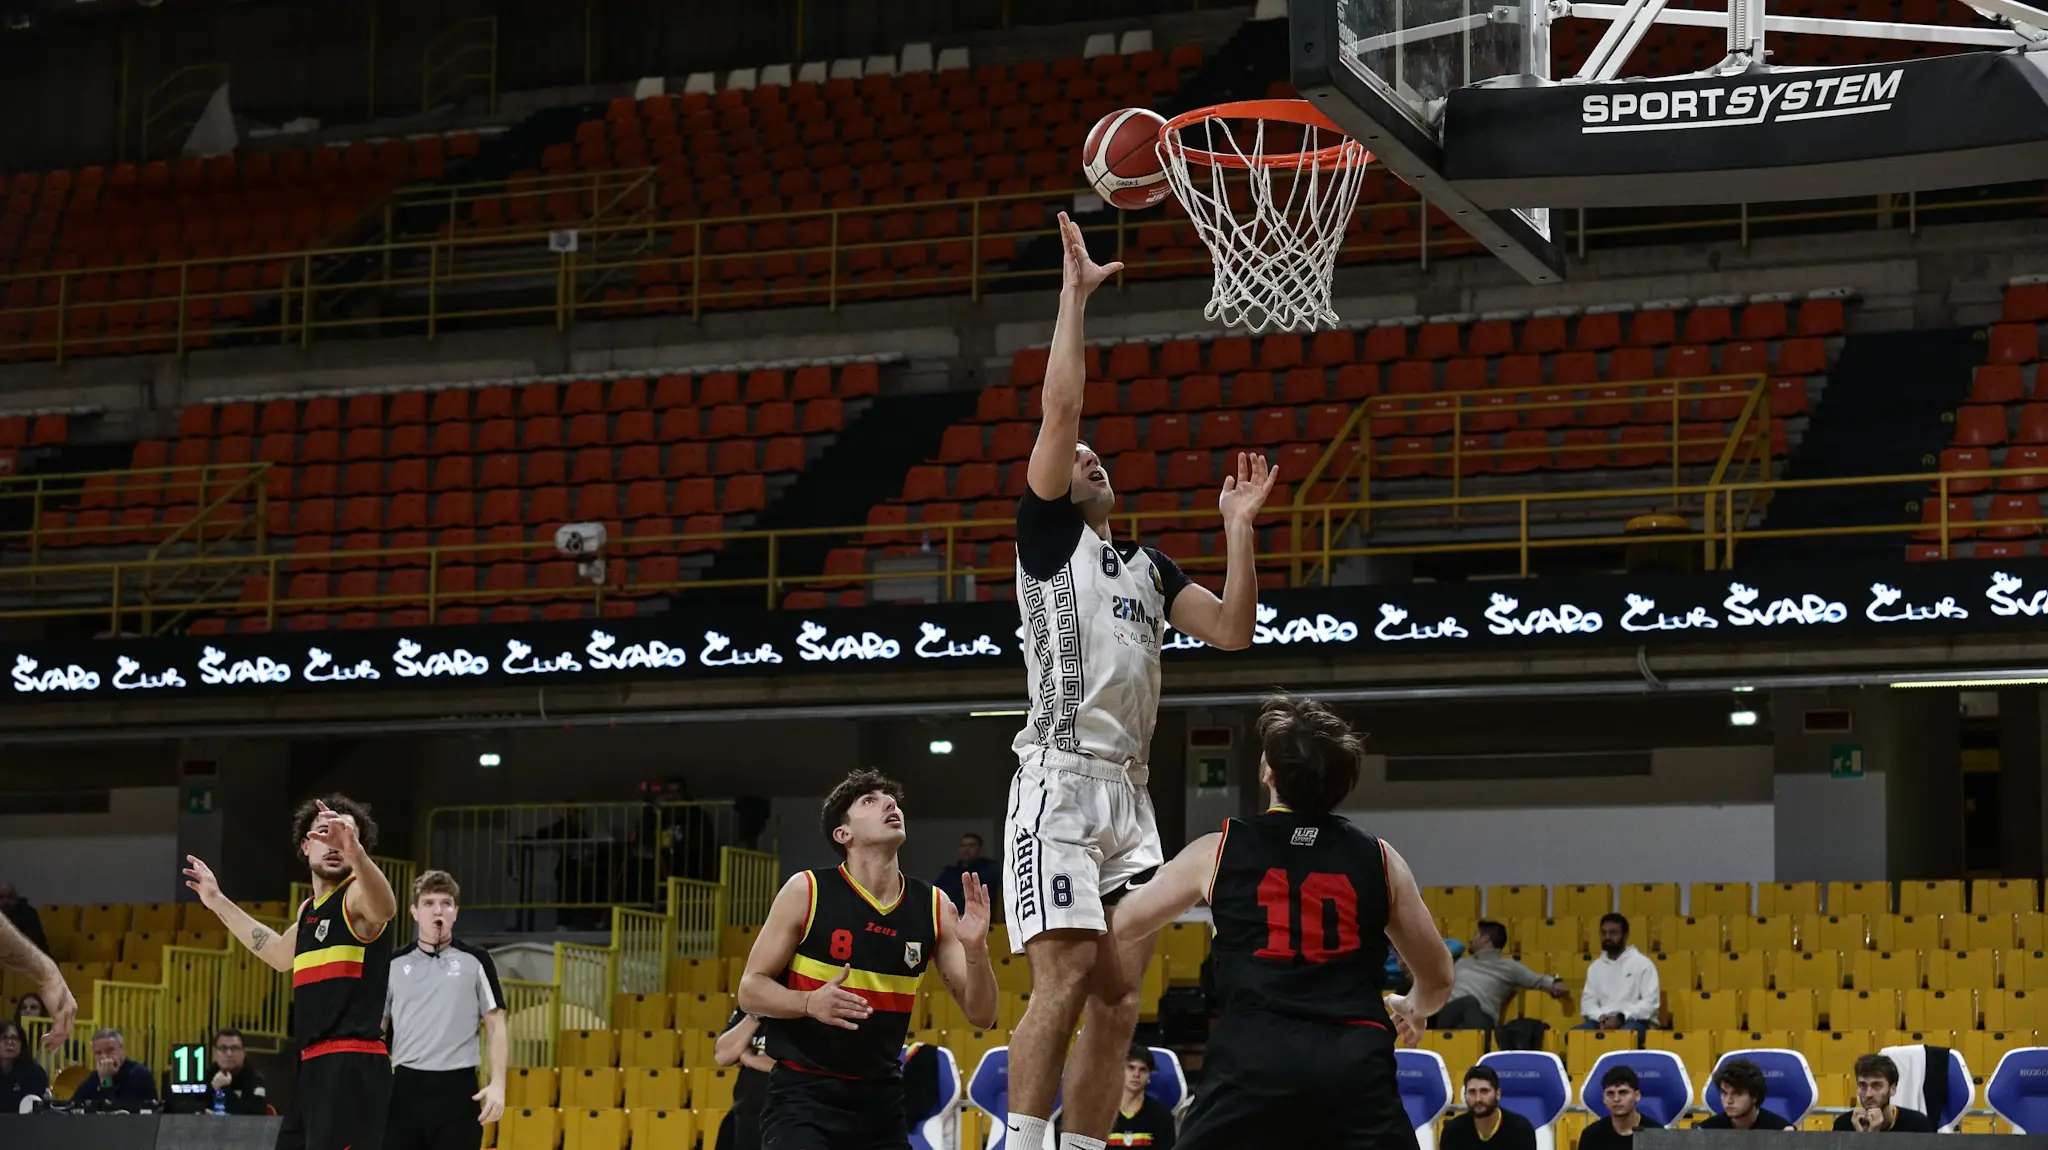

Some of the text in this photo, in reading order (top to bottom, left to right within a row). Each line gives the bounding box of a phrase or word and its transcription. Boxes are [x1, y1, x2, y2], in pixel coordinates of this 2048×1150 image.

[1099, 544, 1122, 579] 8
[1051, 873, 1075, 909] 8
[864, 921, 898, 937] Zeus
[1253, 867, 1361, 964] 10
[829, 928, 853, 960] 8
[173, 1045, 205, 1082] 11
